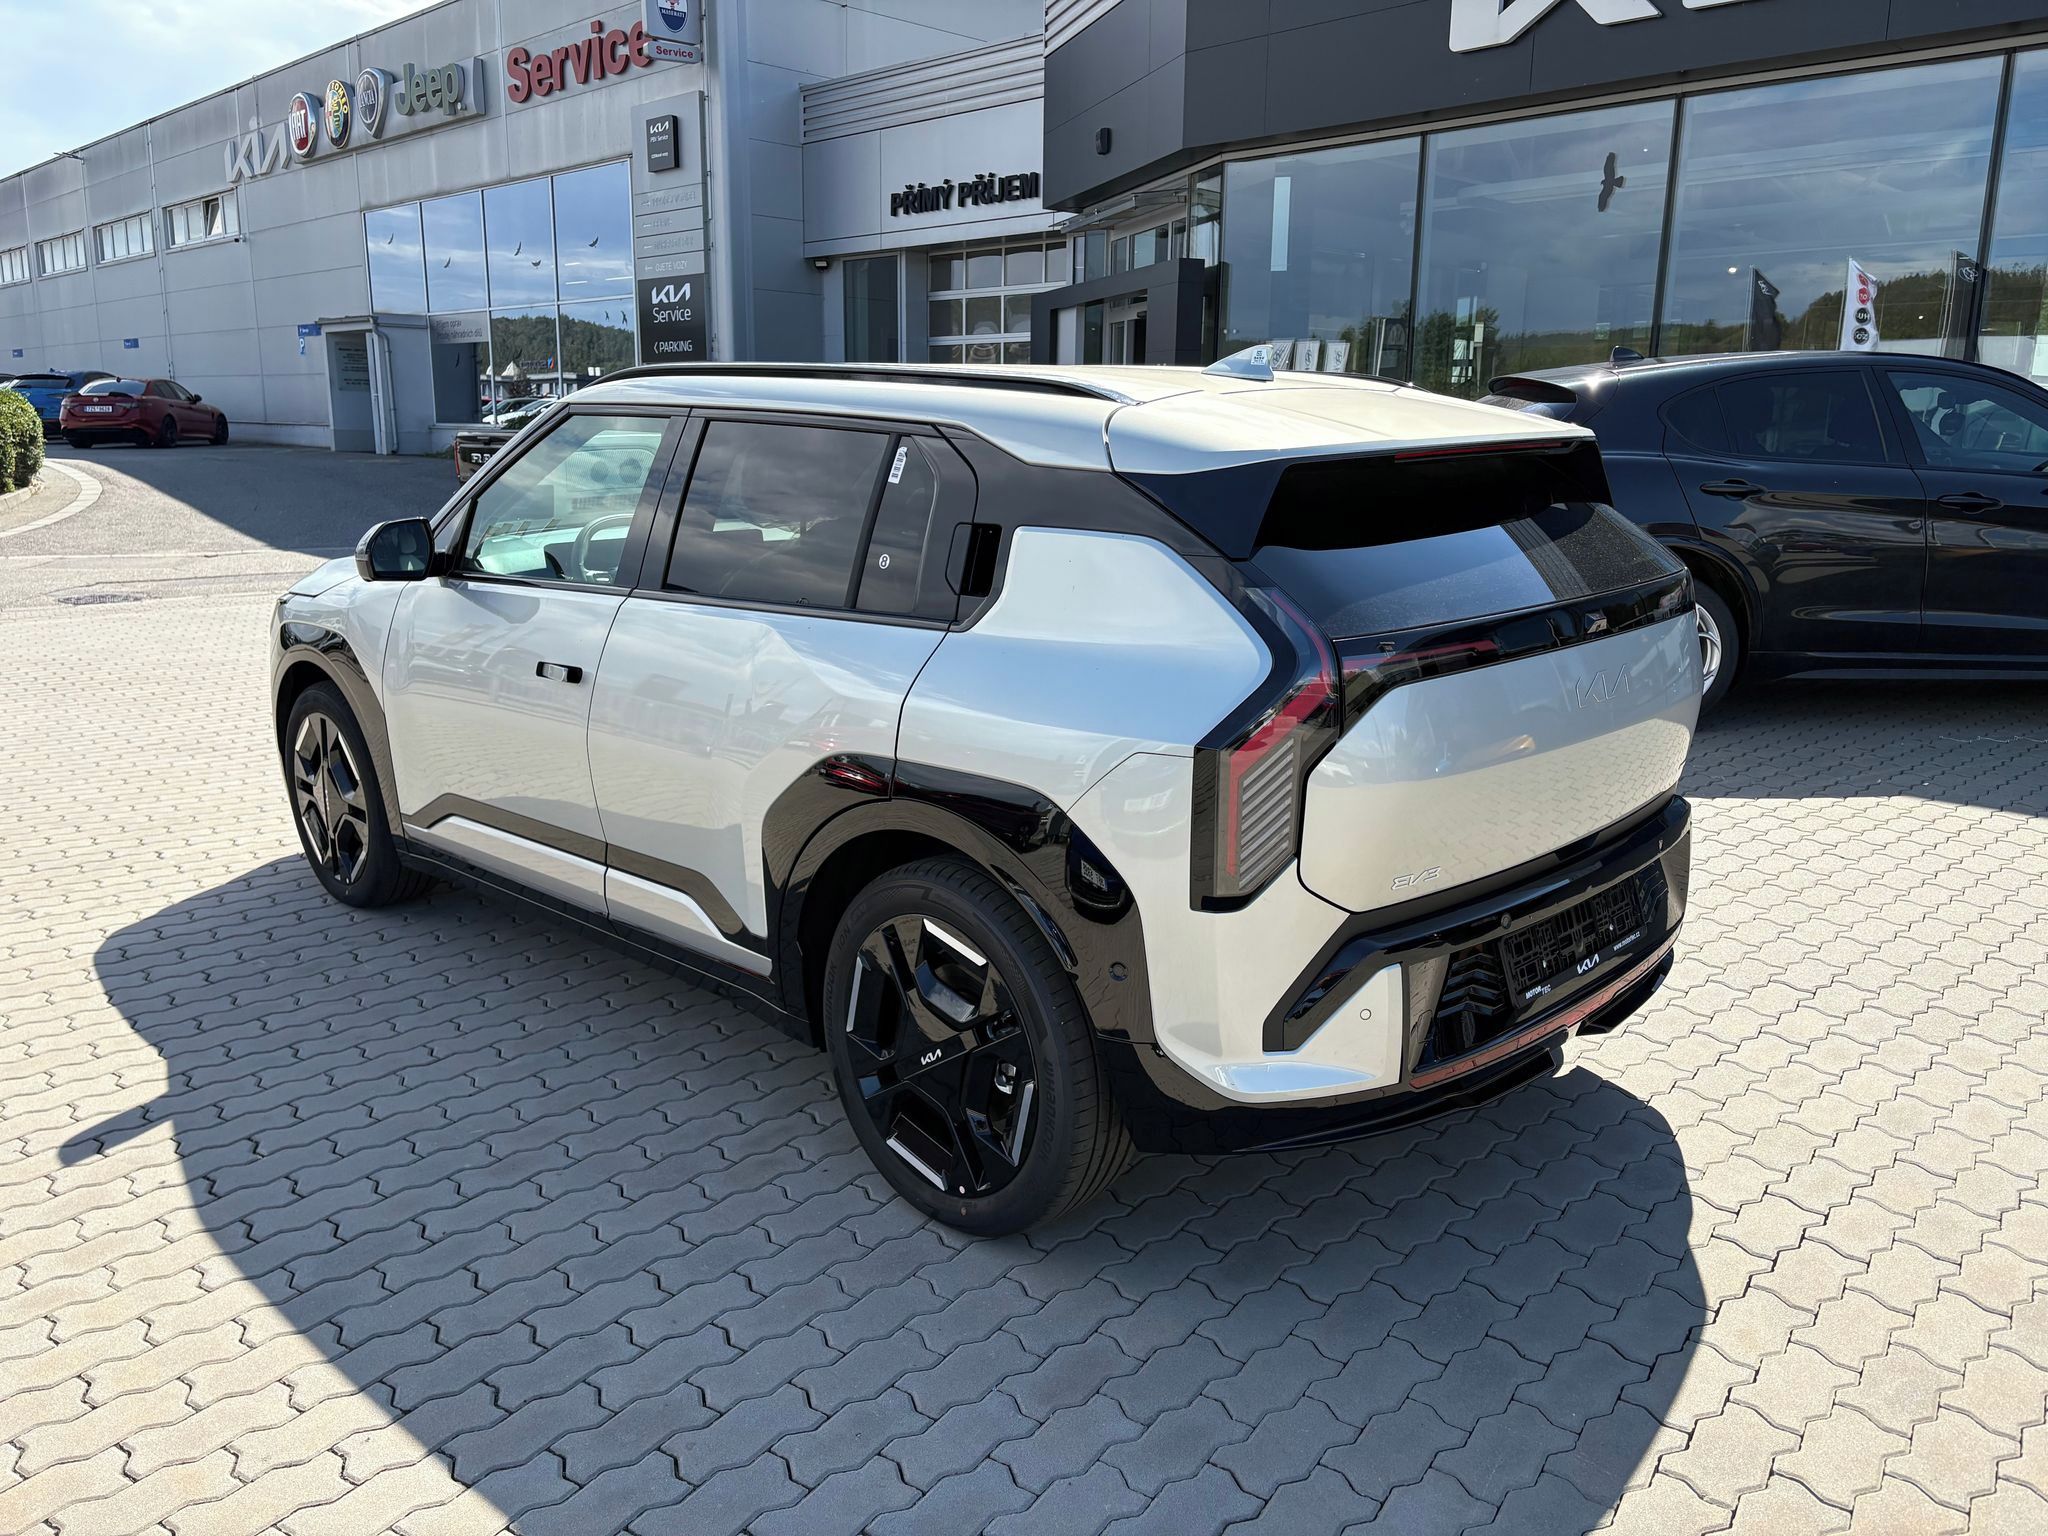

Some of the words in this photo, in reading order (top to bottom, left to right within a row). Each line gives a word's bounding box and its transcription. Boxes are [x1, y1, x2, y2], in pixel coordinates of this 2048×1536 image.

[507, 20, 652, 103] Service
[655, 45, 694, 59] Service
[395, 62, 464, 116] Jeep
[650, 121, 669, 134] KIA
[224, 121, 291, 183] KIA
[890, 179, 954, 217] PŘÍMÝ
[958, 172, 1040, 208] PŘÍJEM
[651, 282, 691, 305] KIA
[652, 305, 692, 323] Service
[659, 339, 693, 353] PARKING
[1576, 664, 1630, 709] KIA
[1391, 865, 1441, 890] EV3
[1577, 953, 1600, 975] KIA
[920, 1048, 942, 1066] KIA
